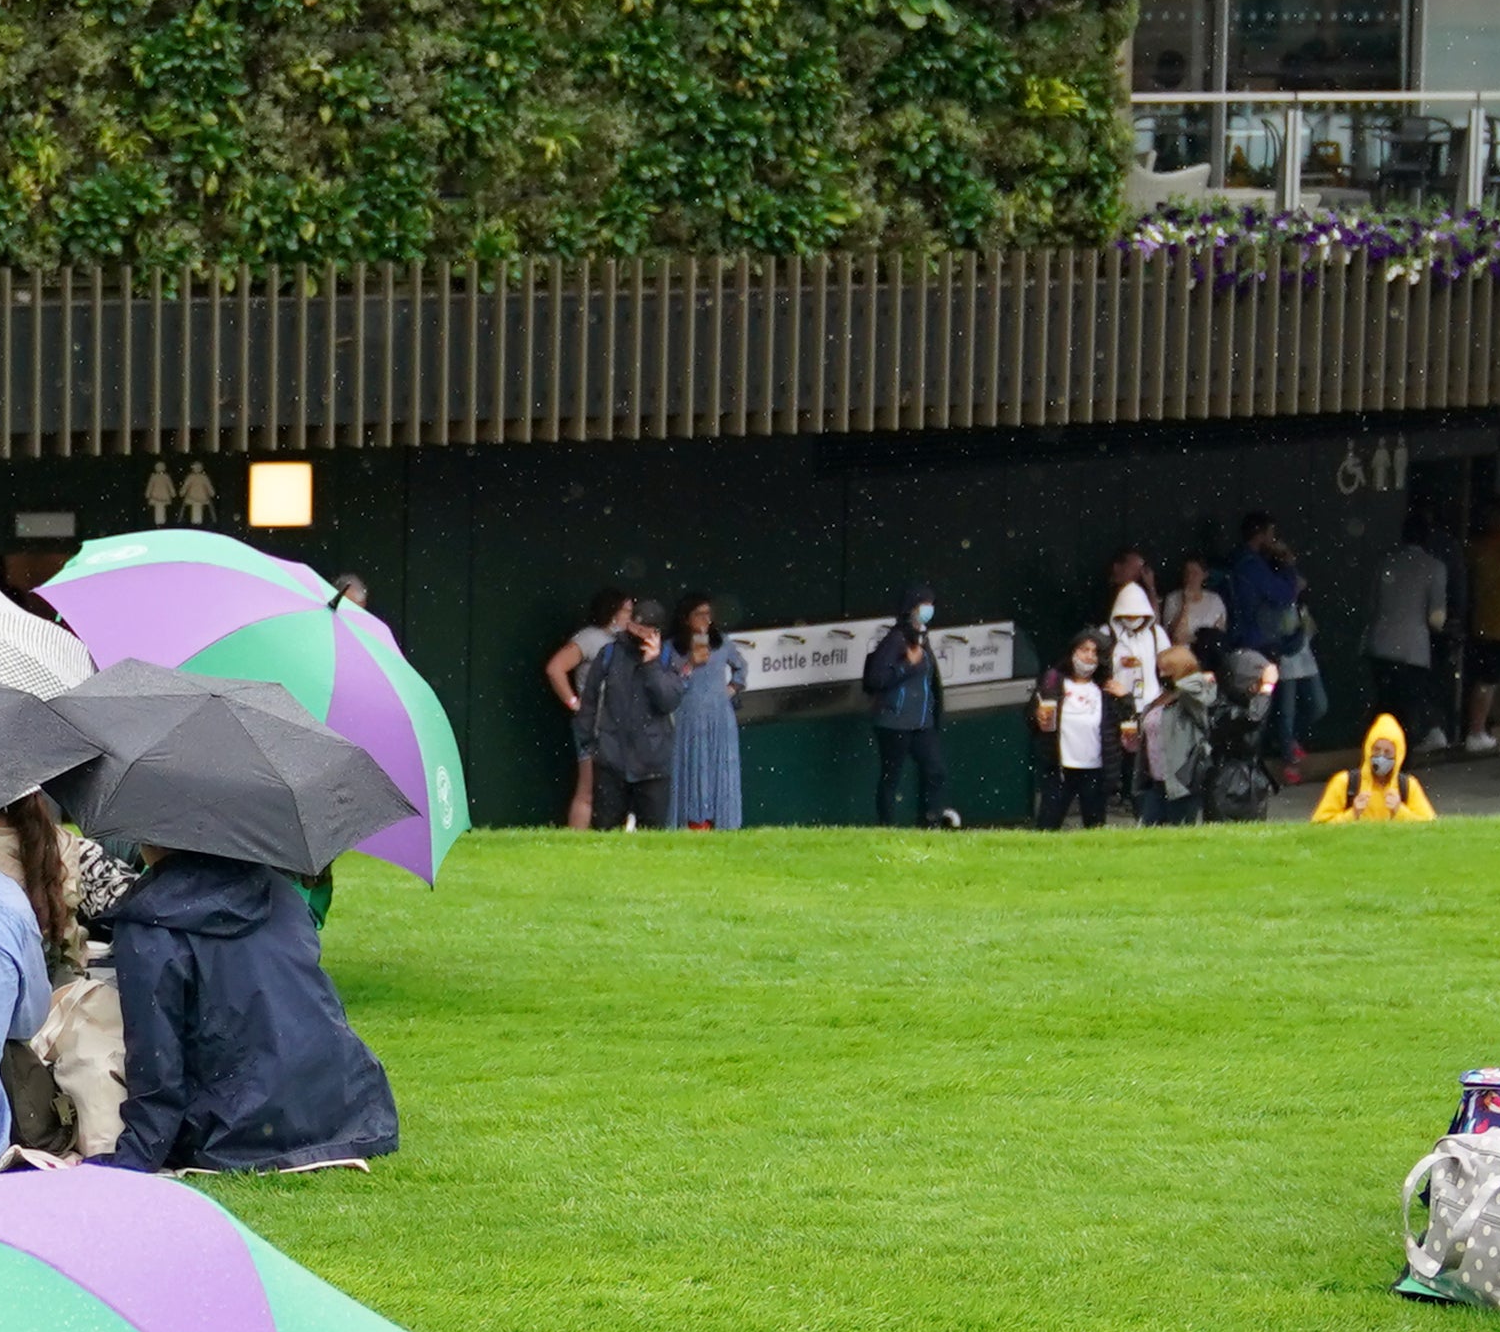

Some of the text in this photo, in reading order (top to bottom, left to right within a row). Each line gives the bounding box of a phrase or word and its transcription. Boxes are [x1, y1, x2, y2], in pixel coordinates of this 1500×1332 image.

[969, 644, 999, 657] Bottle
[762, 648, 849, 673] Bottle Refill
[968, 661, 995, 675] Refill
